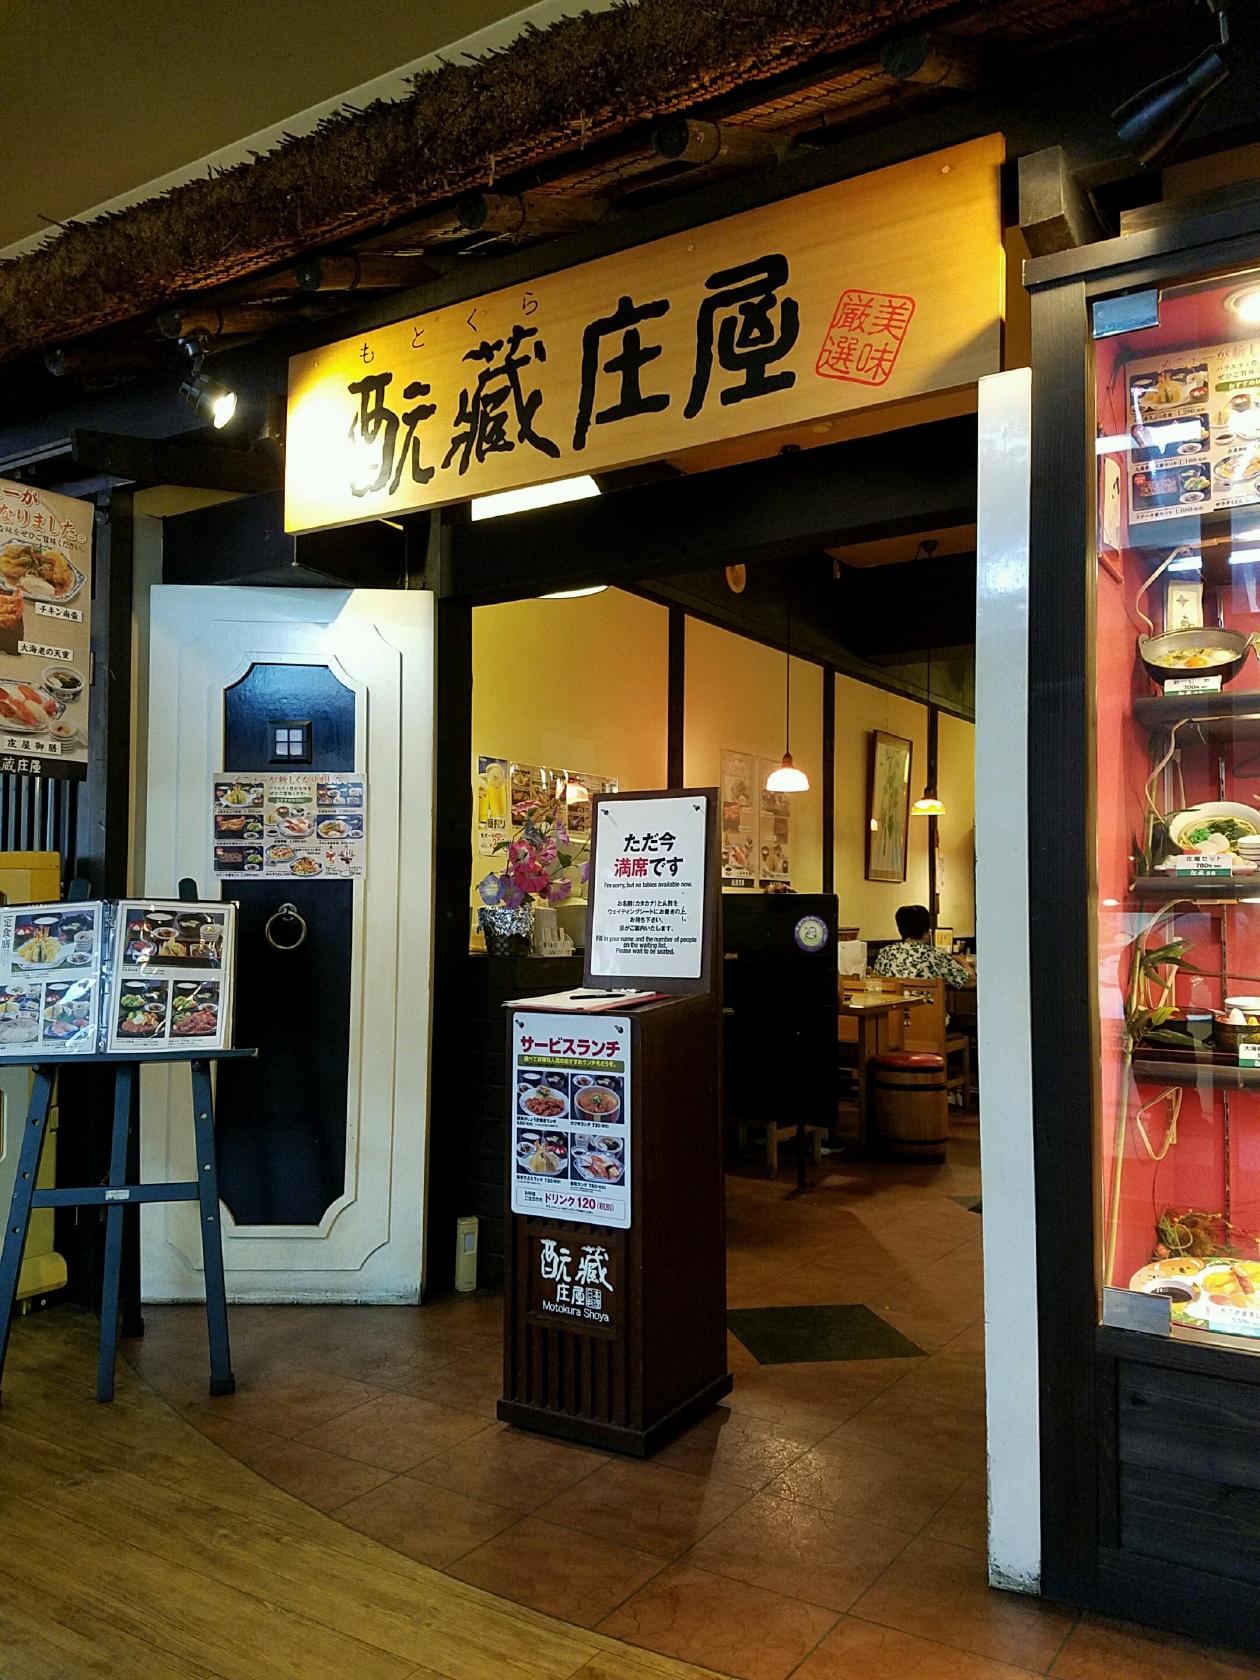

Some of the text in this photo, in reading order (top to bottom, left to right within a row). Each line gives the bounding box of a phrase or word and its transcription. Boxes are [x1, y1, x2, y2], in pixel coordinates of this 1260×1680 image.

[21, 643, 70, 660] 大海老の天重
[623, 832, 676, 852] ただ今
[614, 857, 684, 877] 満席です
[520, 1036, 621, 1058] サービスランチ
[544, 1193, 575, 1208] ドリンク
[575, 1196, 596, 1210] 120
[542, 1299, 610, 1323] Motokura Shoya
